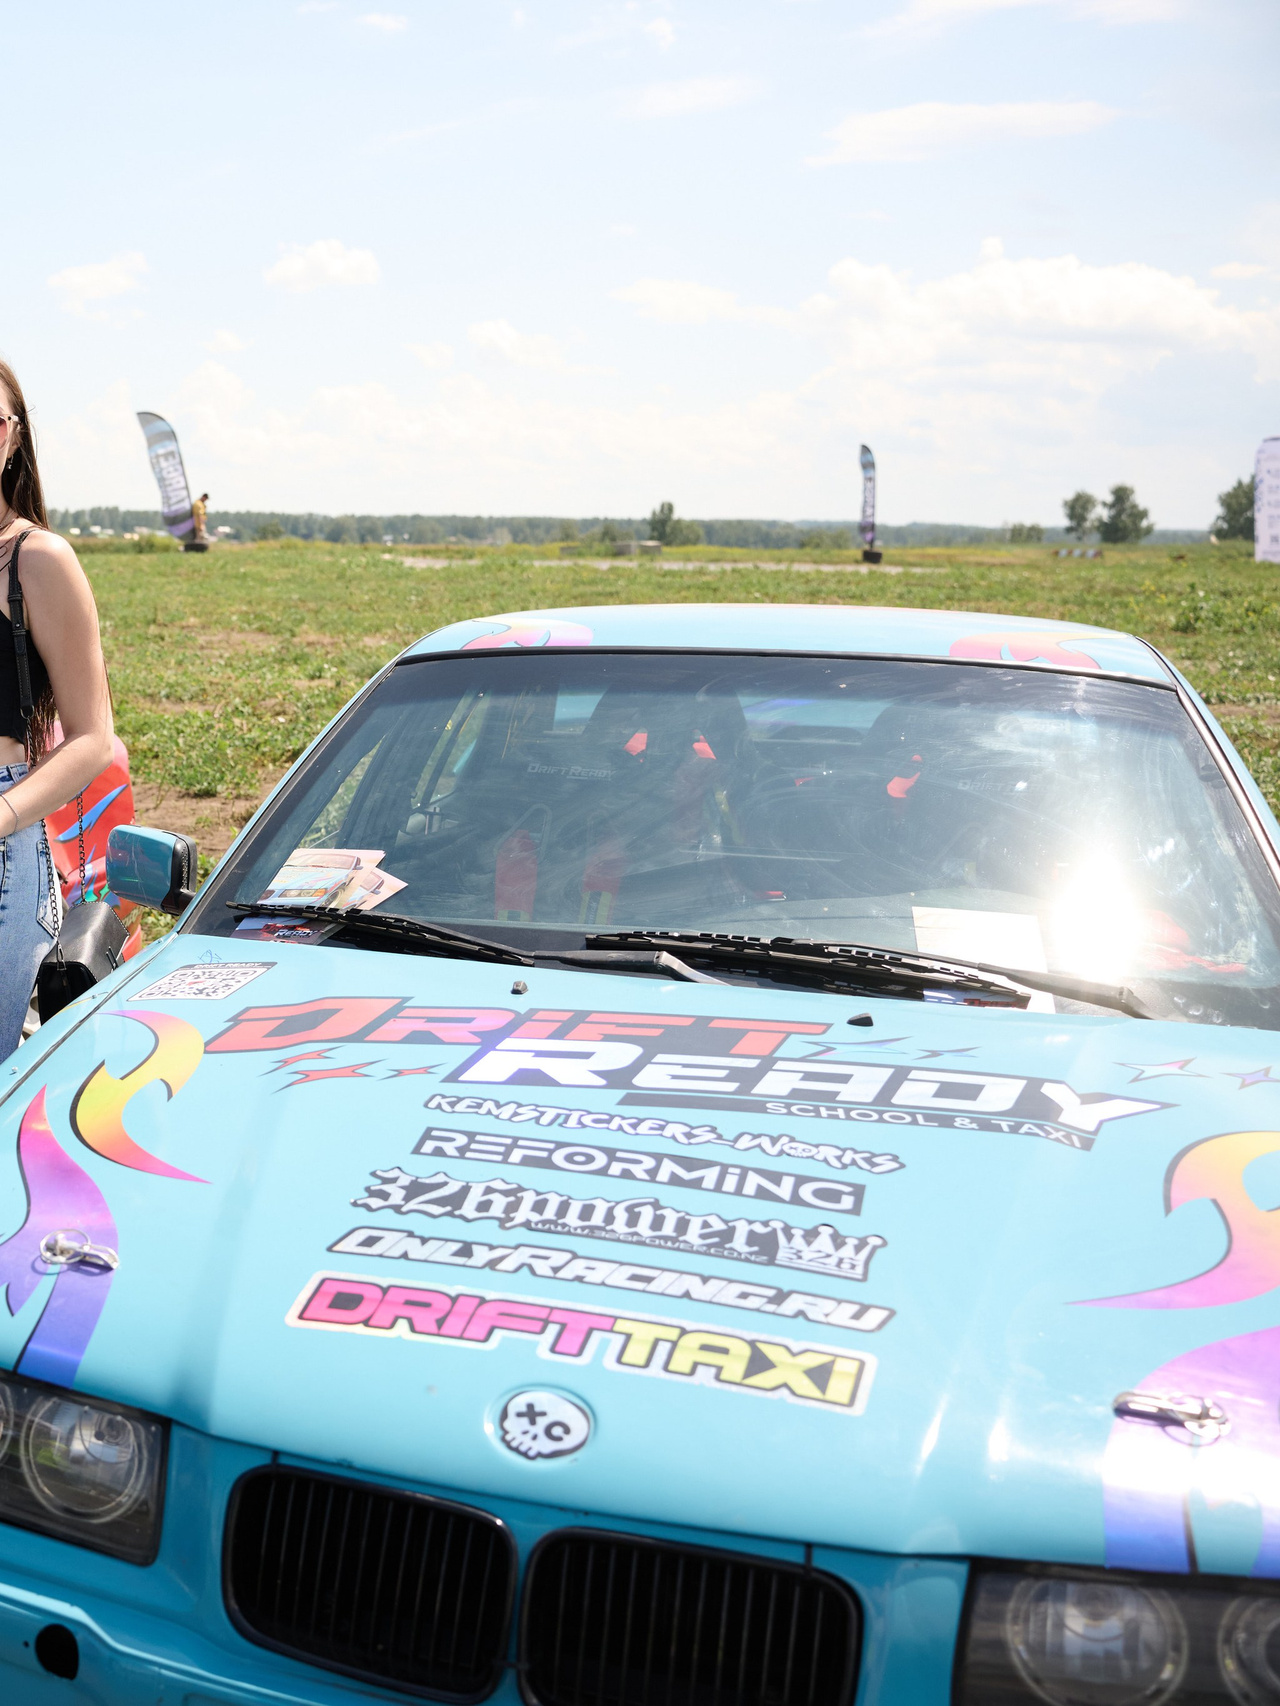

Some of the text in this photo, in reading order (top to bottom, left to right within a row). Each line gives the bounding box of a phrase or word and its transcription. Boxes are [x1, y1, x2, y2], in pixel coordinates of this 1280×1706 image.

[205, 997, 828, 1055] DRIFT
[458, 1037, 1162, 1132] READY
[766, 1102, 1083, 1148] SCHOOL & TAXI
